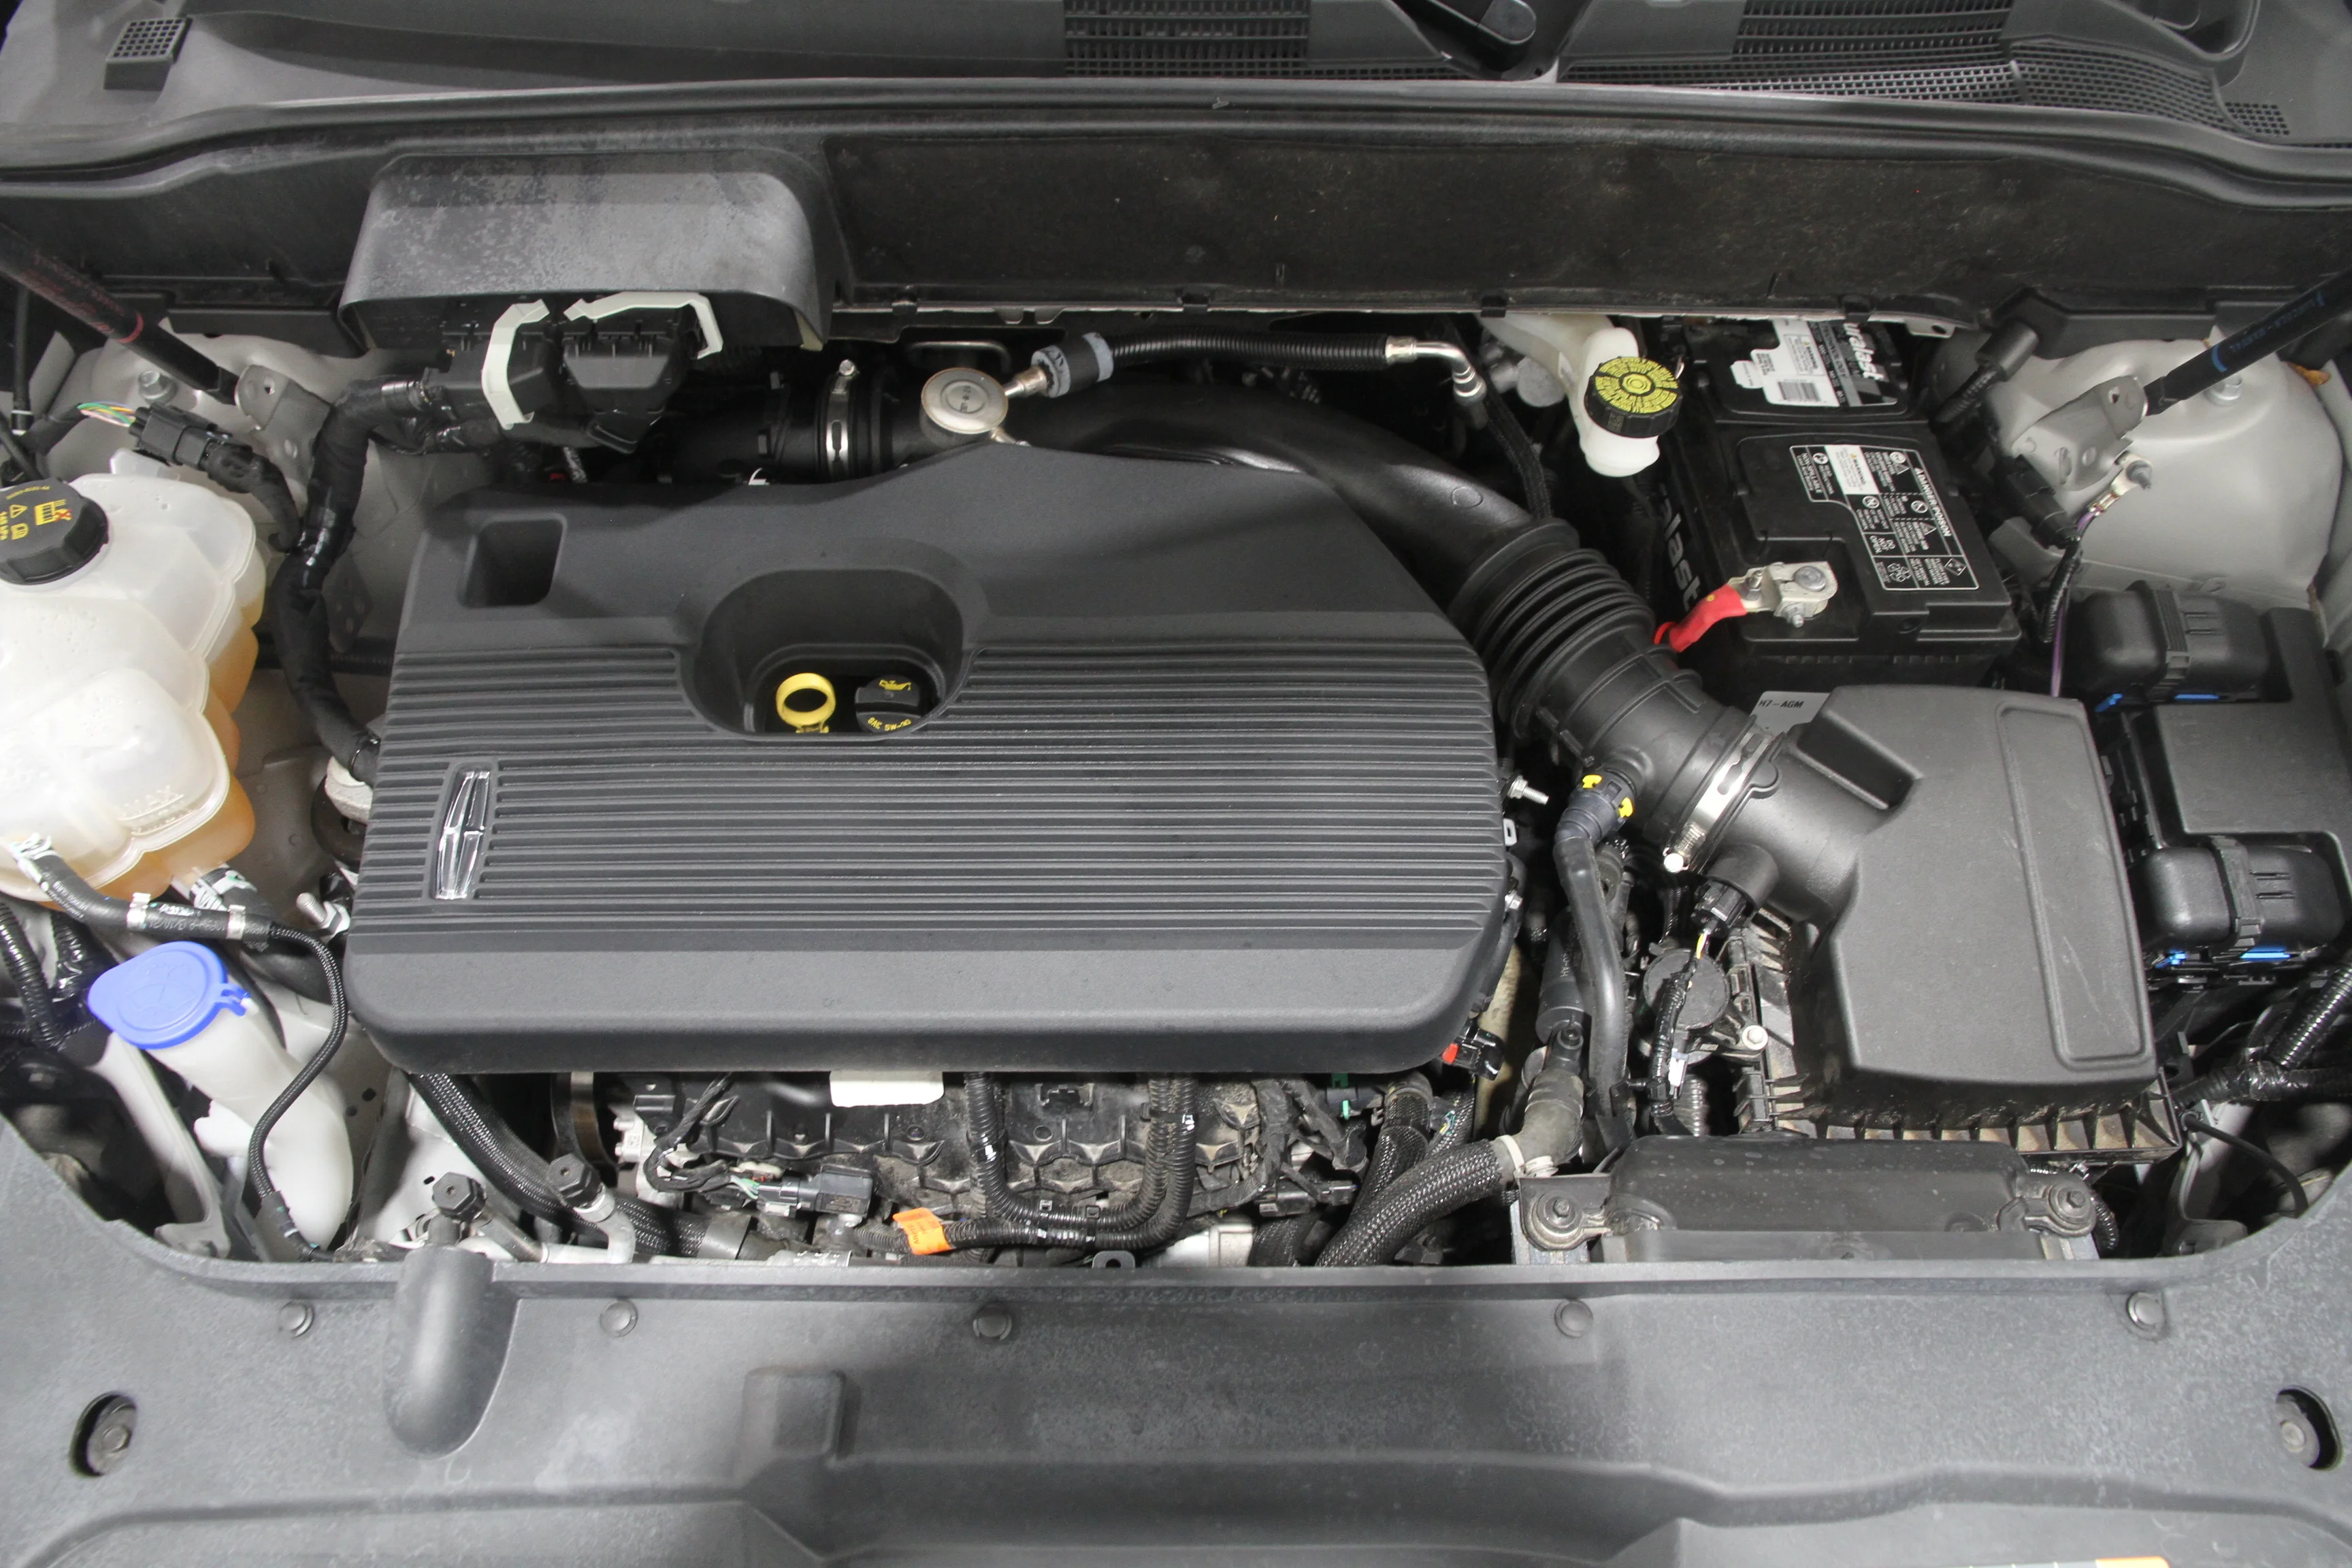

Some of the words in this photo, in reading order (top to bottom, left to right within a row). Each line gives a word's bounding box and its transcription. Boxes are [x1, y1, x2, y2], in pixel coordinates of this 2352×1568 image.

[1842, 321, 1886, 380] uralast
[1916, 473, 1938, 506] DANGER
[1931, 506, 1951, 537] POISON
